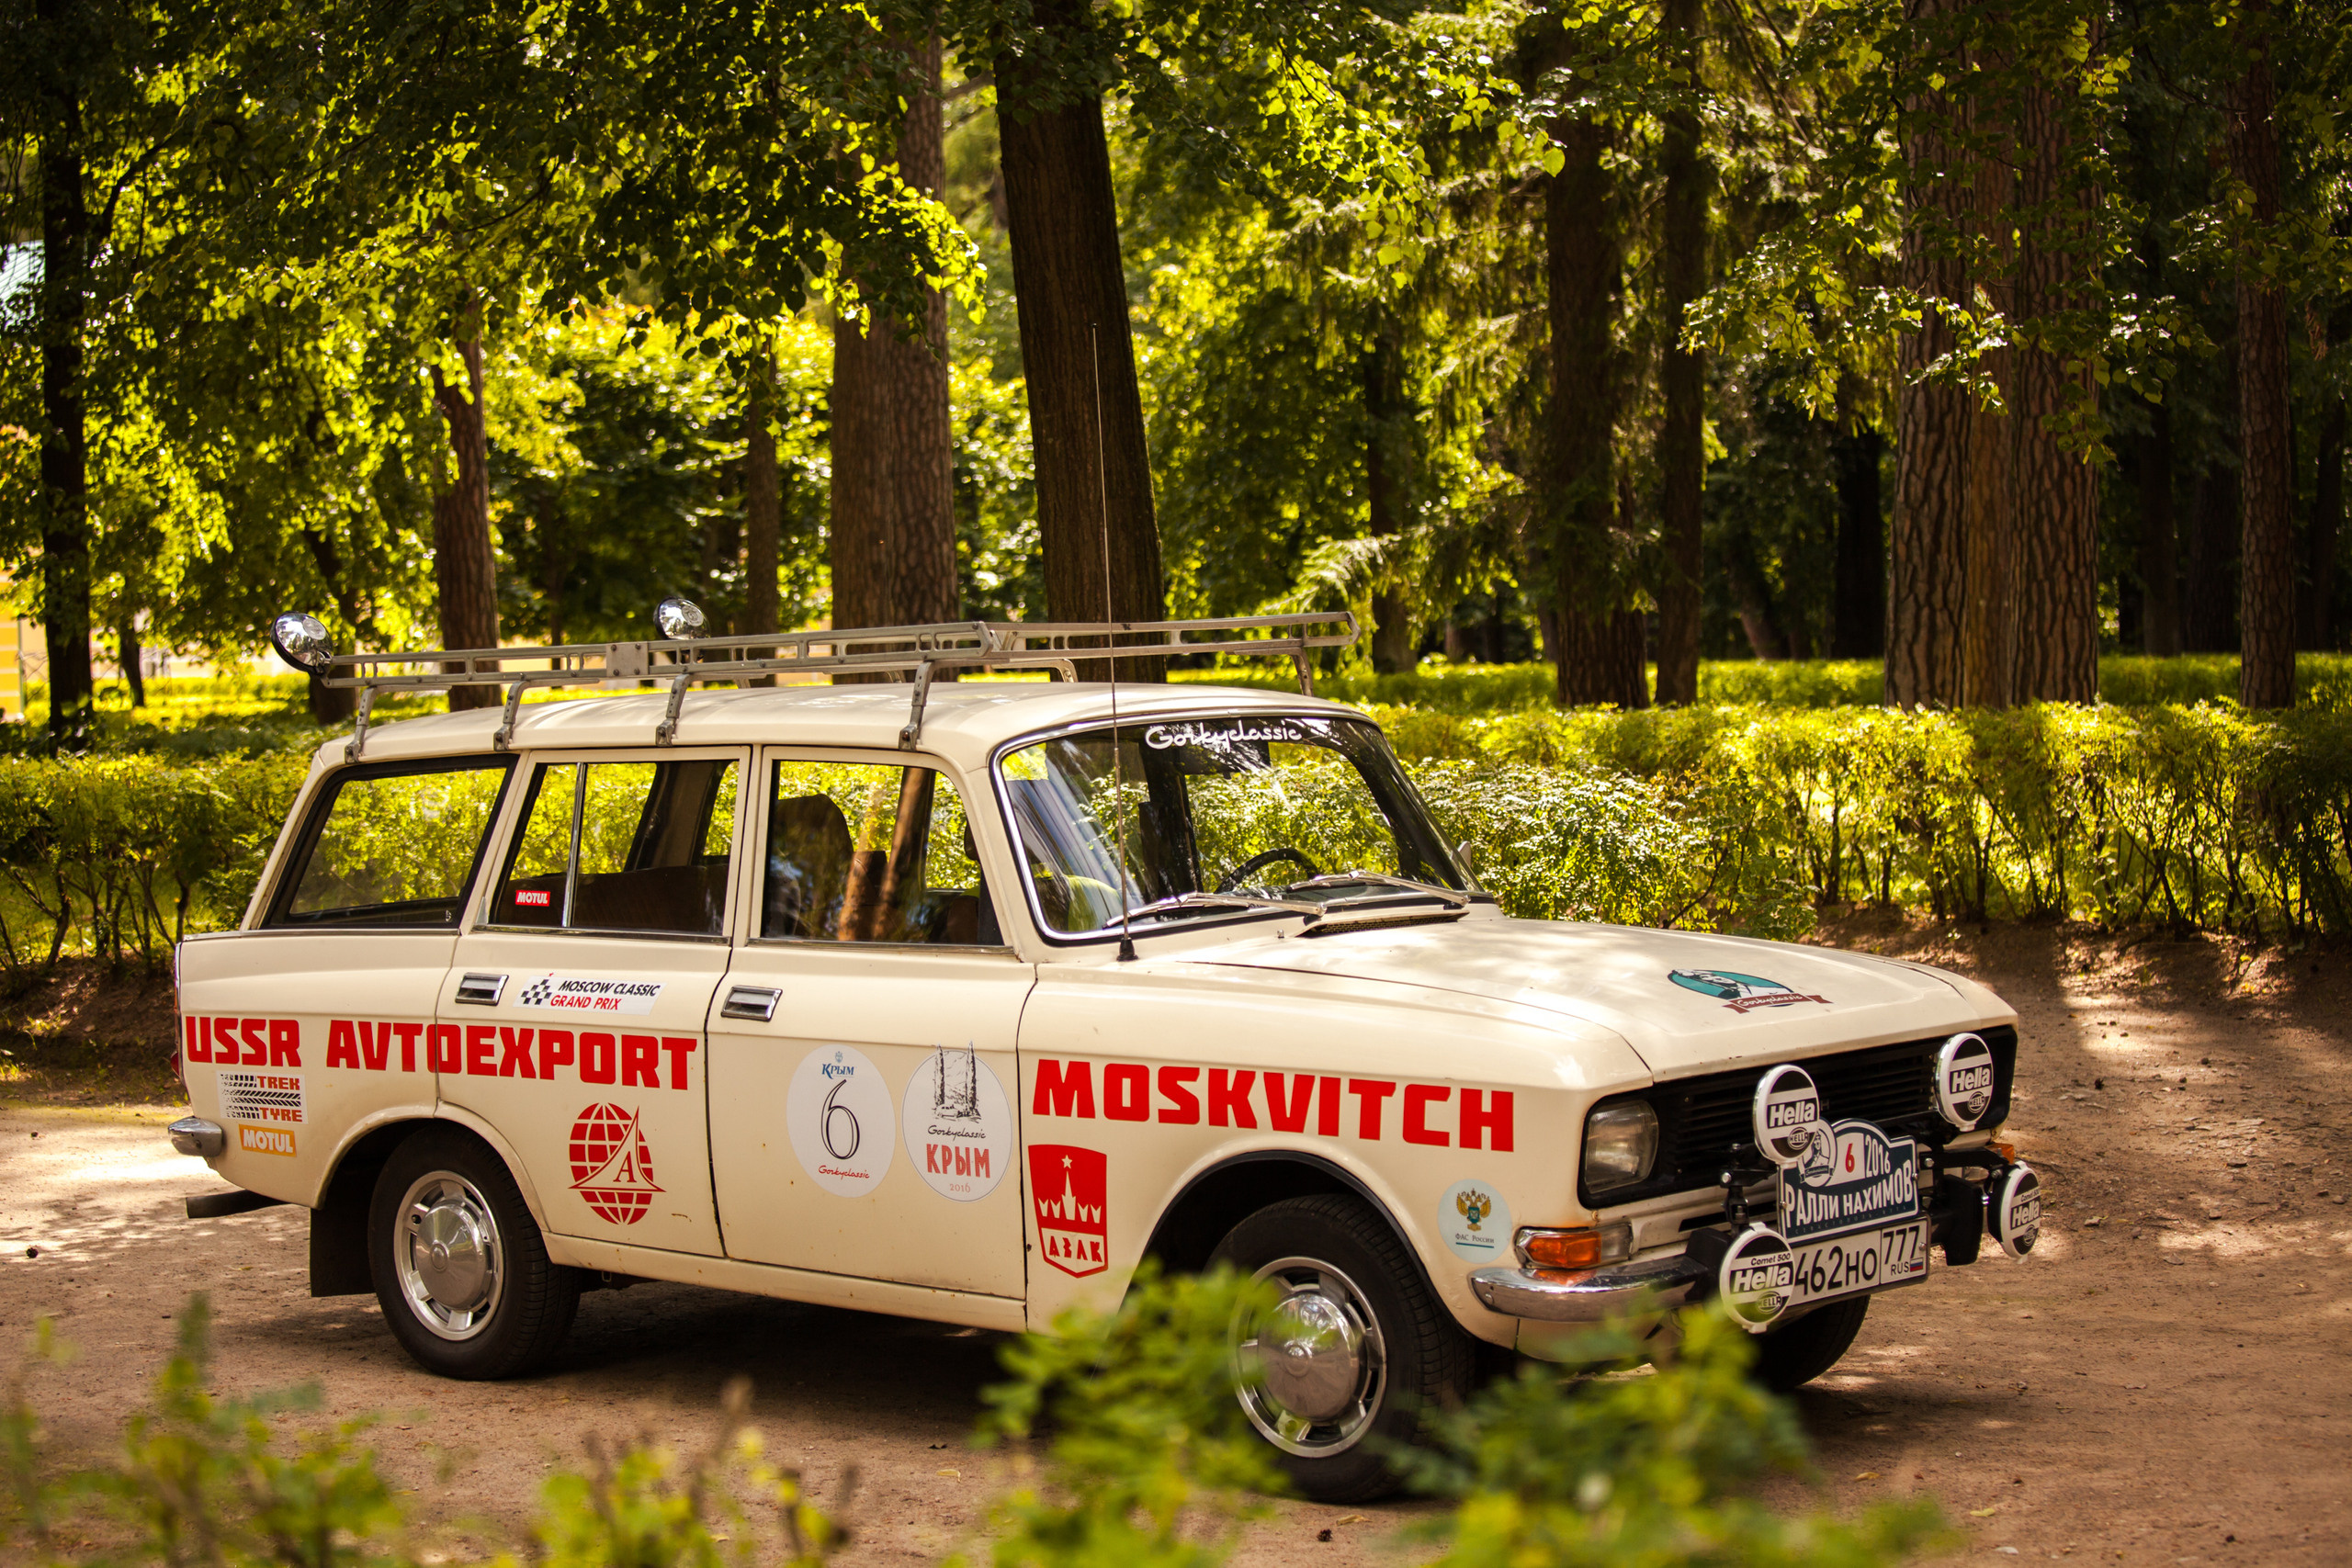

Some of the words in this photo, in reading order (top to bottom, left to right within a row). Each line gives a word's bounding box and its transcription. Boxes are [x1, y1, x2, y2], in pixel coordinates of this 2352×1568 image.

[1145, 719, 1302, 753] Gorkyclassic
[516, 892, 548, 904] MOTUL
[558, 980, 615, 994] MOSCOW
[613, 983, 661, 997] CLASSIC
[550, 995, 592, 1009] GRAND
[594, 998, 622, 1010] PRIX
[186, 1016, 302, 1067] USSR
[326, 1019, 698, 1090] AVTOEXPORT
[257, 1076, 300, 1090] TREK
[1951, 1066, 1990, 1093] Hella
[259, 1107, 303, 1122] TYRE
[821, 1078, 860, 1159] 6
[1032, 1059, 1514, 1153] MOSKVITCH
[1770, 1100, 1815, 1128] Hella
[243, 1129, 294, 1154] MOTUL
[927, 1124, 986, 1141] Gorkyclassic
[1790, 1131, 1809, 1143] HELLA
[926, 1144, 990, 1179] КРЫМ
[1845, 1143, 1855, 1173] 6
[1865, 1134, 1890, 1178] 2016
[818, 1165, 870, 1180] Gorkyclassic
[949, 1183, 970, 1193] 2016
[1785, 1183, 1839, 1228] РАЛЛИ
[1843, 1159, 1914, 1216] НАХИМОВ
[2012, 1200, 2040, 1228] Hella
[1455, 1233, 1469, 1241] ФАС
[1751, 1255, 1776, 1266] Comet
[1778, 1253, 1791, 1263] 500
[1794, 1246, 1877, 1295] 462НО
[1883, 1225, 1920, 1264] 777
[1891, 1261, 1909, 1275] RUS
[1733, 1266, 1791, 1294] Hella
